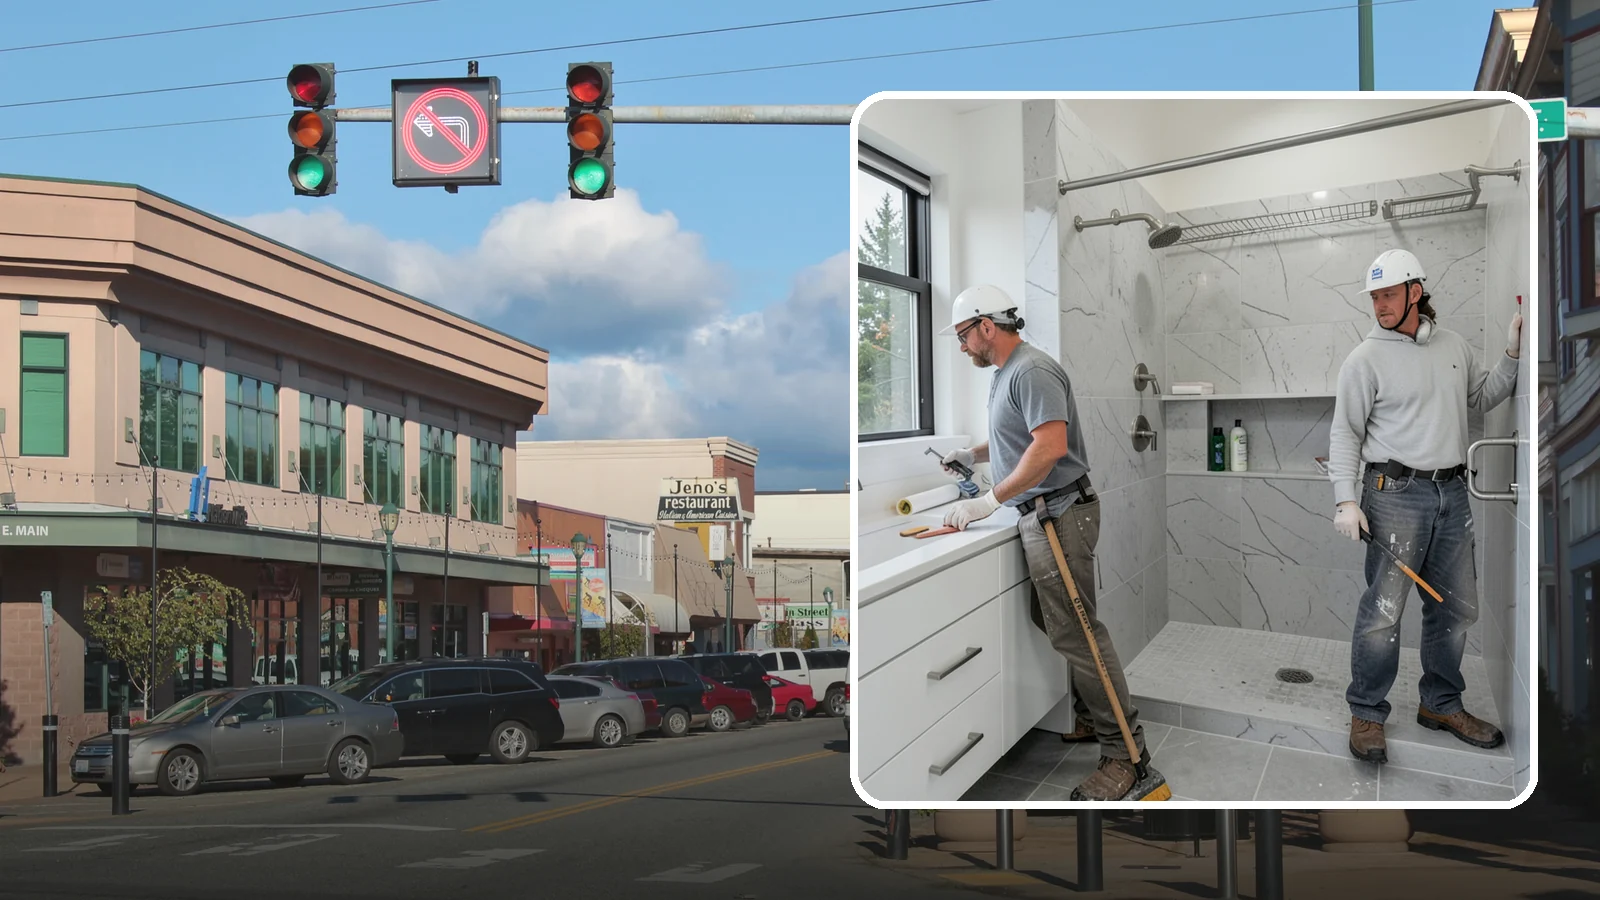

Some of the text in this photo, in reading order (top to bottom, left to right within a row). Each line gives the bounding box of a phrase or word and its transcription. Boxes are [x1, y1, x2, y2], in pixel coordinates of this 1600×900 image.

[669, 480, 727, 494] Jeno's
[665, 496, 731, 509] restaurant
[659, 510, 681, 519] Italian
[686, 509, 714, 519] American
[715, 509, 737, 519] Cuisine
[2, 525, 49, 536] E. MAIN
[797, 607, 828, 616] Street
